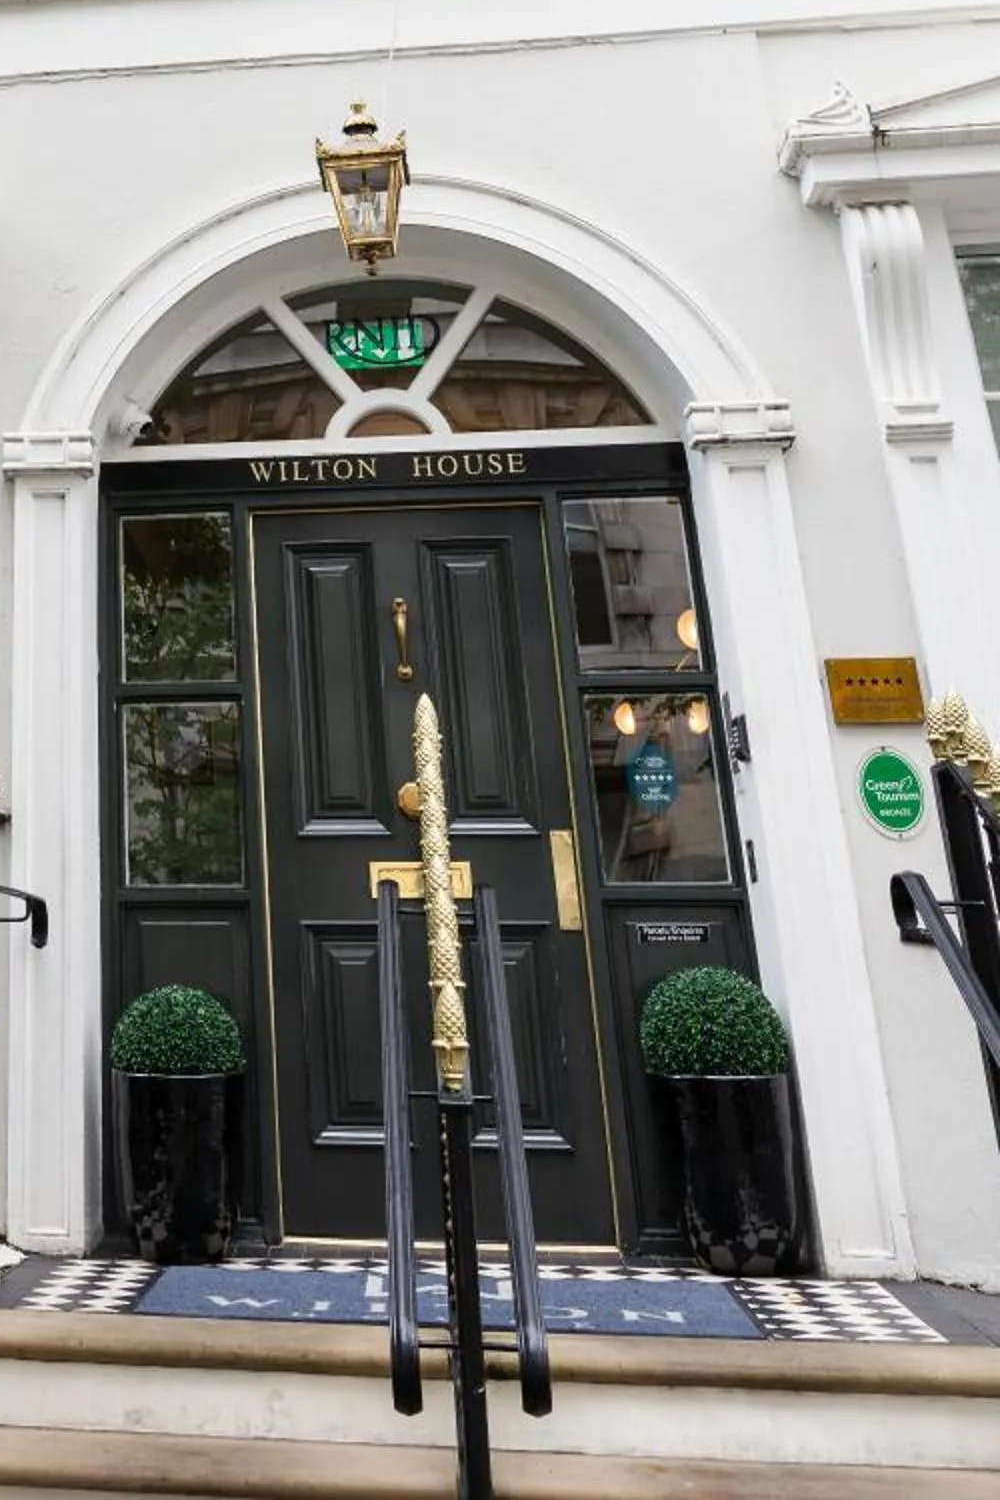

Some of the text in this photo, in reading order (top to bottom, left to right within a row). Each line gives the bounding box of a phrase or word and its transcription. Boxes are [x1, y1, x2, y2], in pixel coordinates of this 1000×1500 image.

[250, 452, 528, 483] WILTON HOUSE
[865, 779, 900, 791] Green
[875, 791, 920, 802] Tourism
